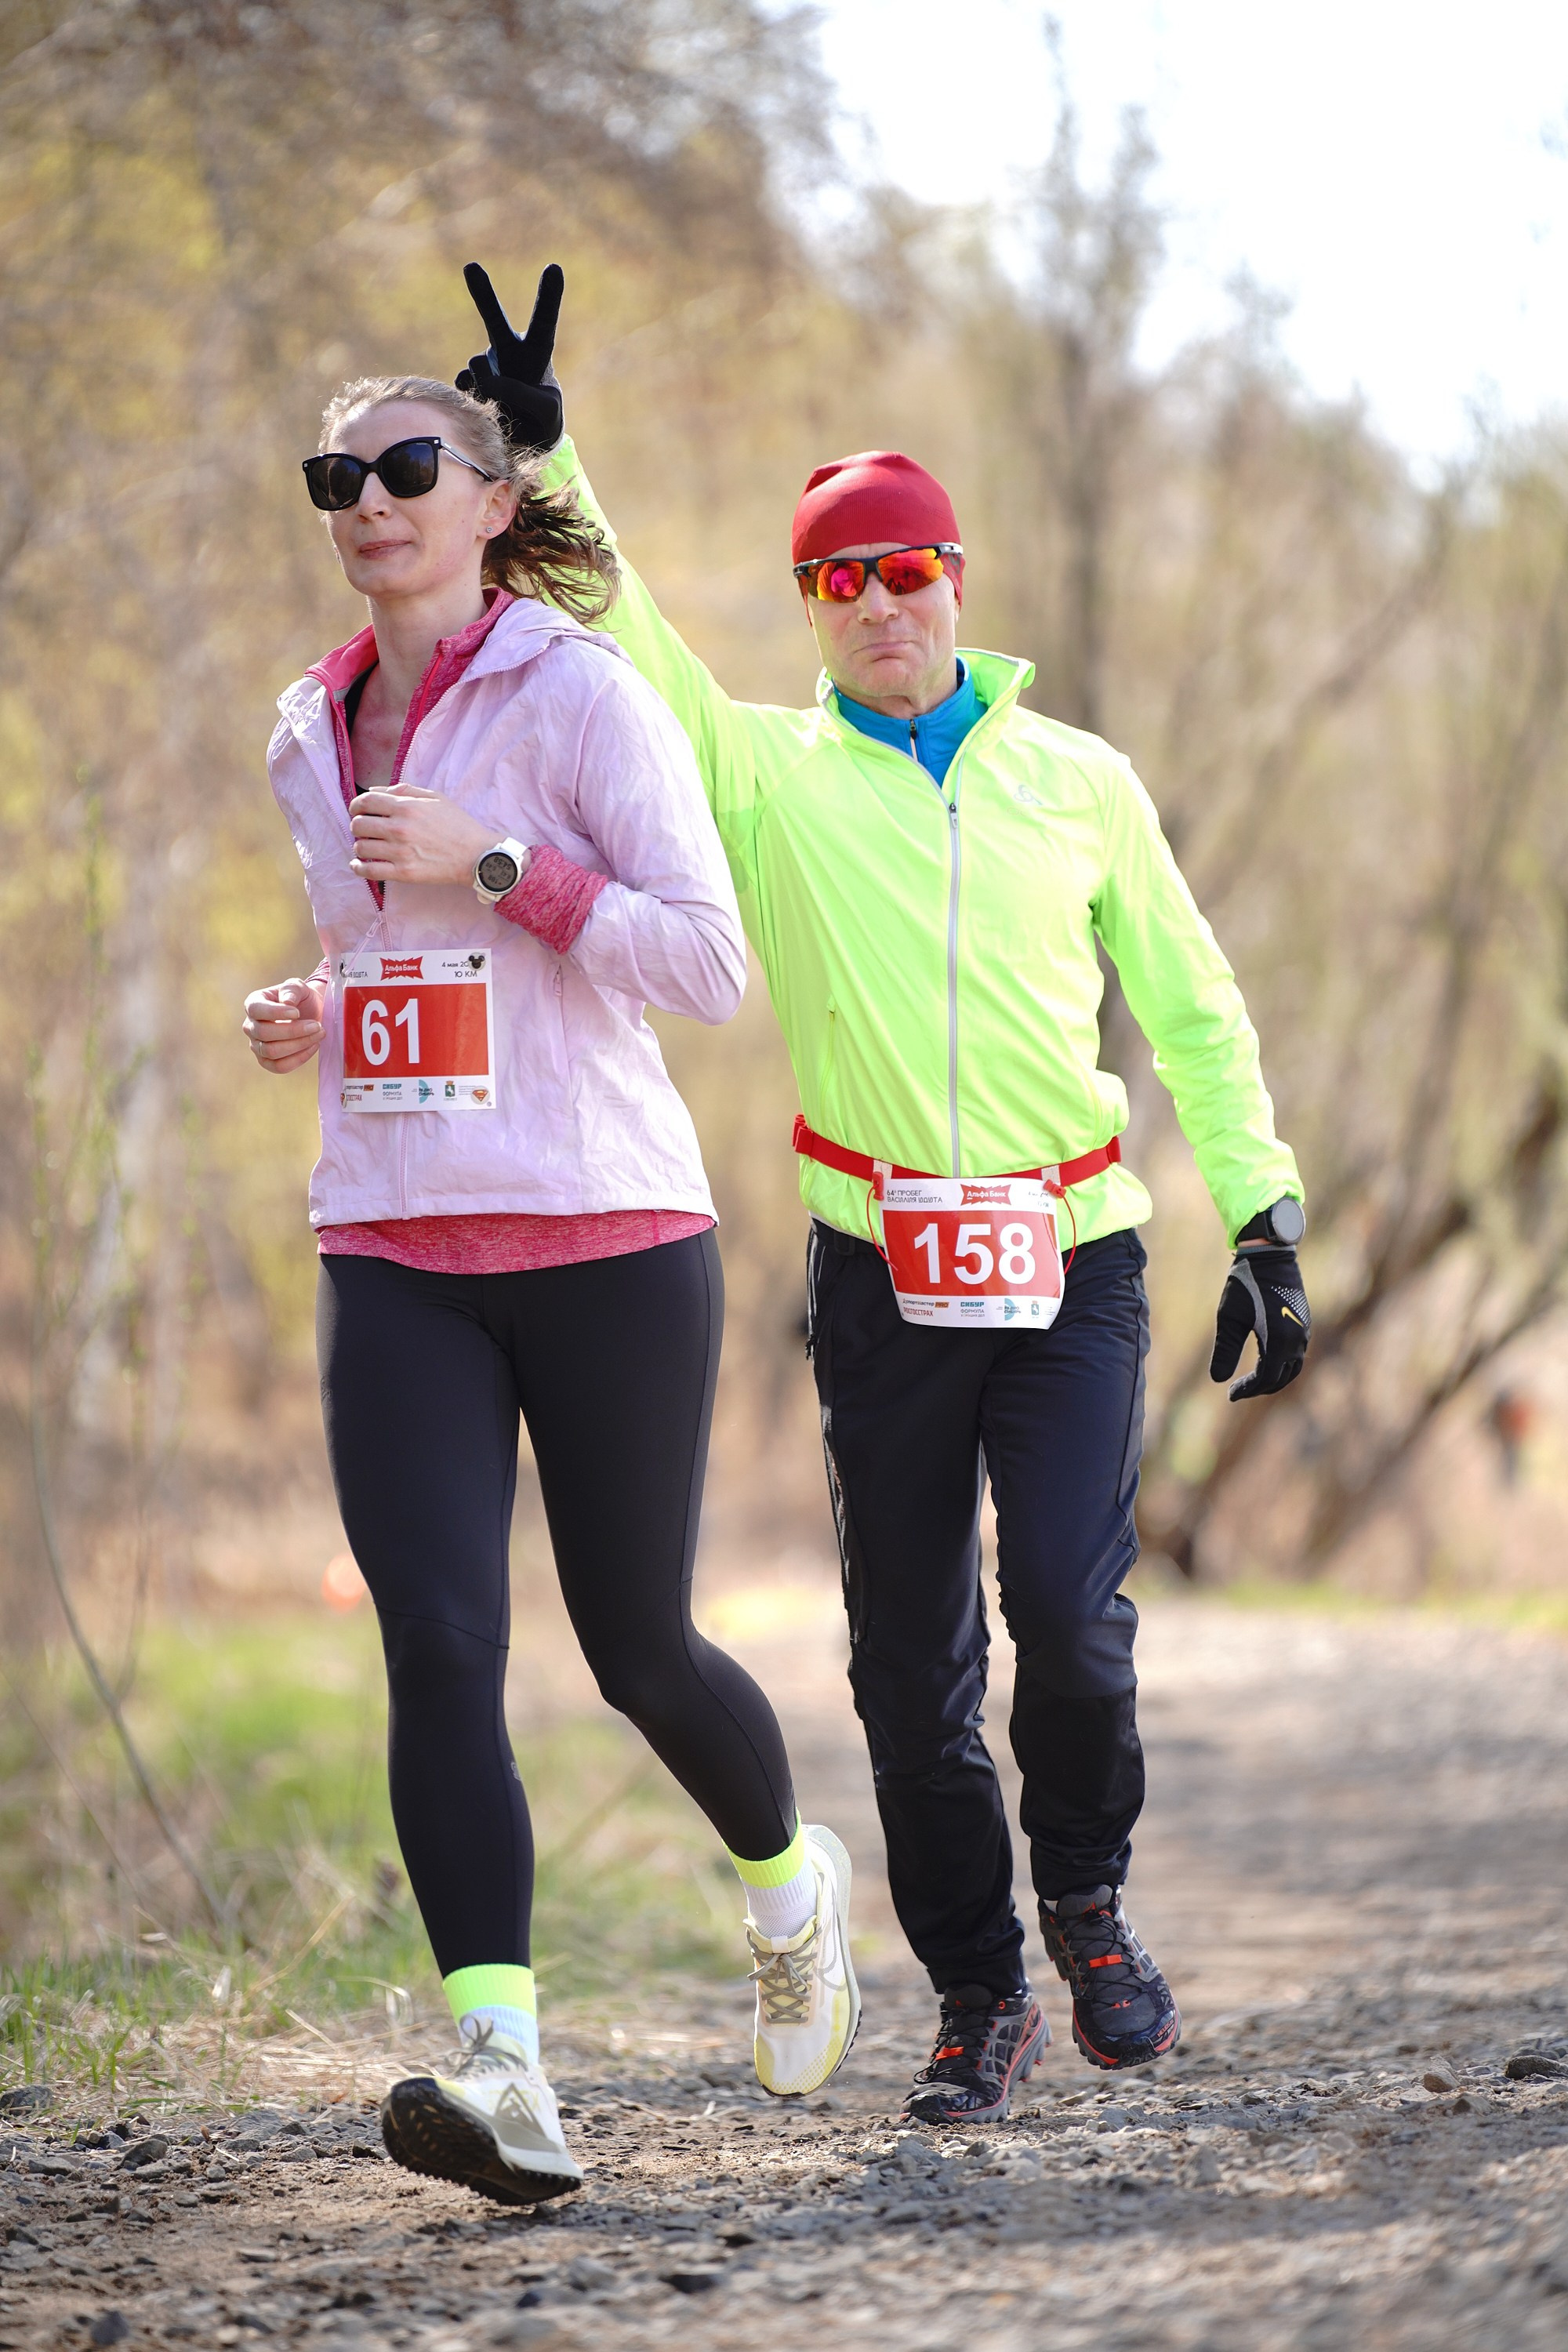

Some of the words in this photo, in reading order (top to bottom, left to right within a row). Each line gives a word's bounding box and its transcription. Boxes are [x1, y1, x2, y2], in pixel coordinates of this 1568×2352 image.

[384, 964, 402, 975] Альфа
[361, 998, 421, 1066] 61
[967, 1191, 989, 1200] Альфа
[913, 1223, 1036, 1285] 158
